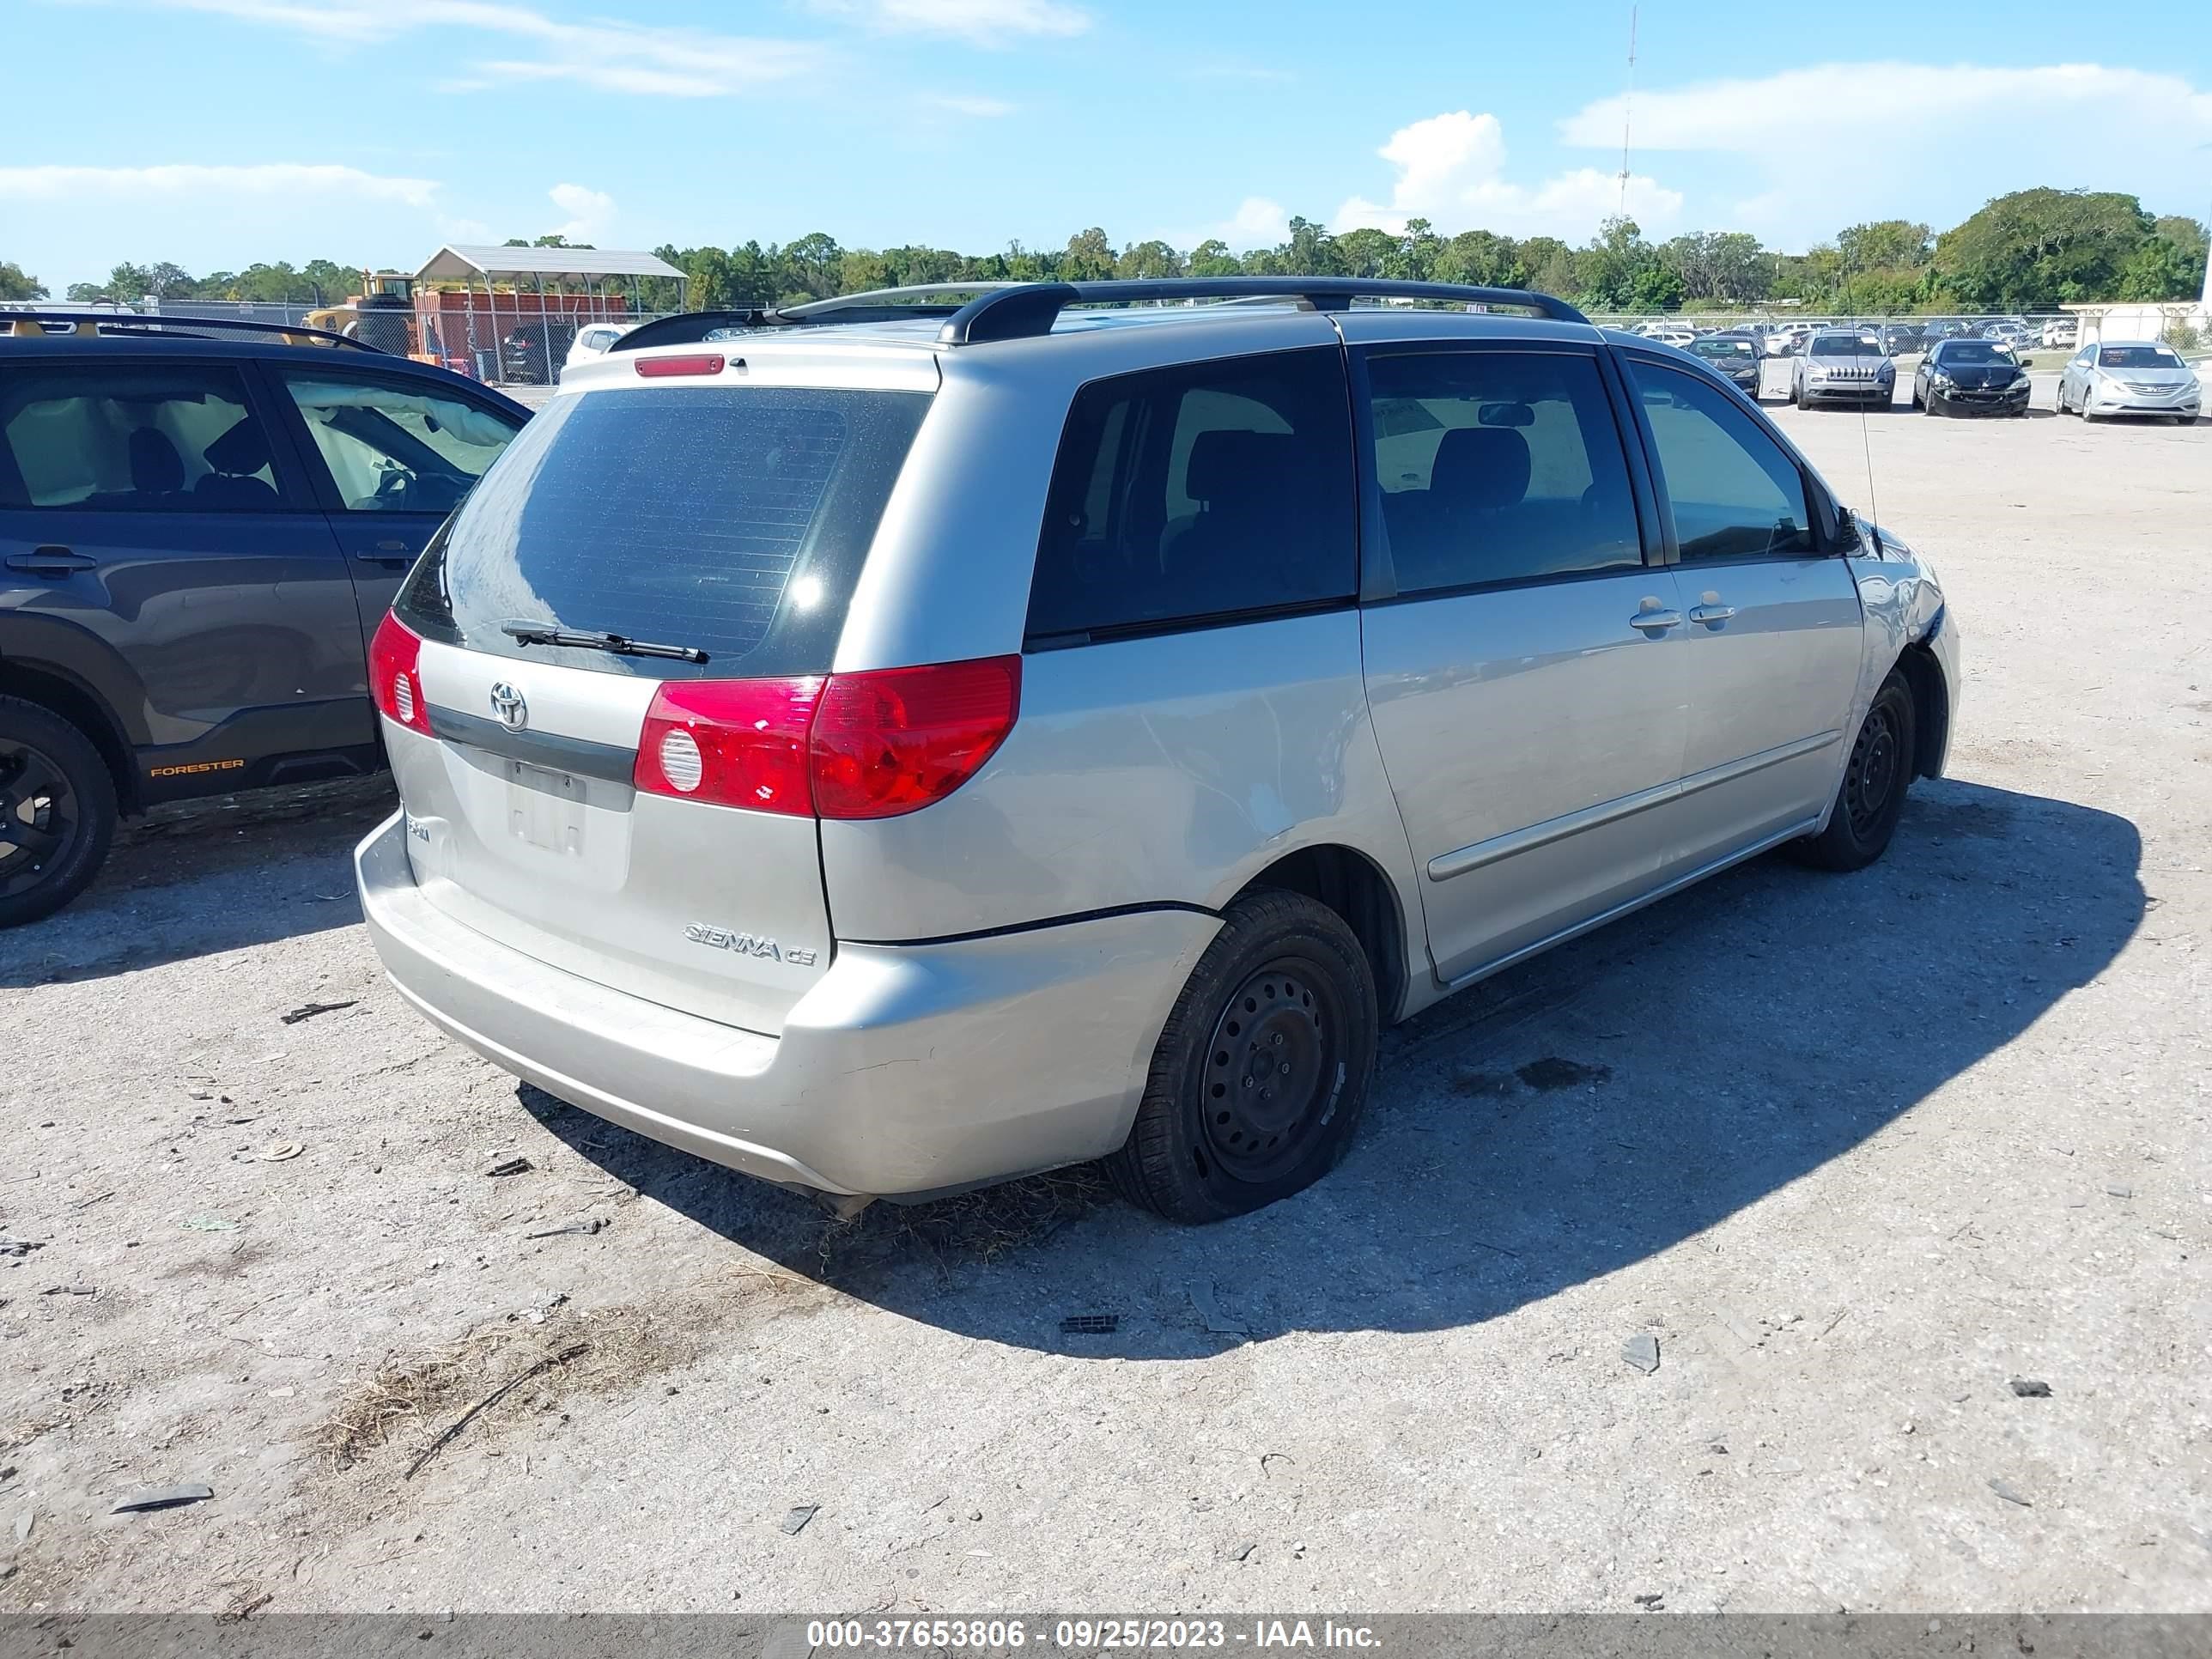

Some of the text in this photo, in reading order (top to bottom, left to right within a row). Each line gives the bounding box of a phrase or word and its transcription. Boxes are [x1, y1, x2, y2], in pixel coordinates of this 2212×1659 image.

[150, 759, 245, 777] FORESTER
[682, 921, 817, 967] SIENNA CE
